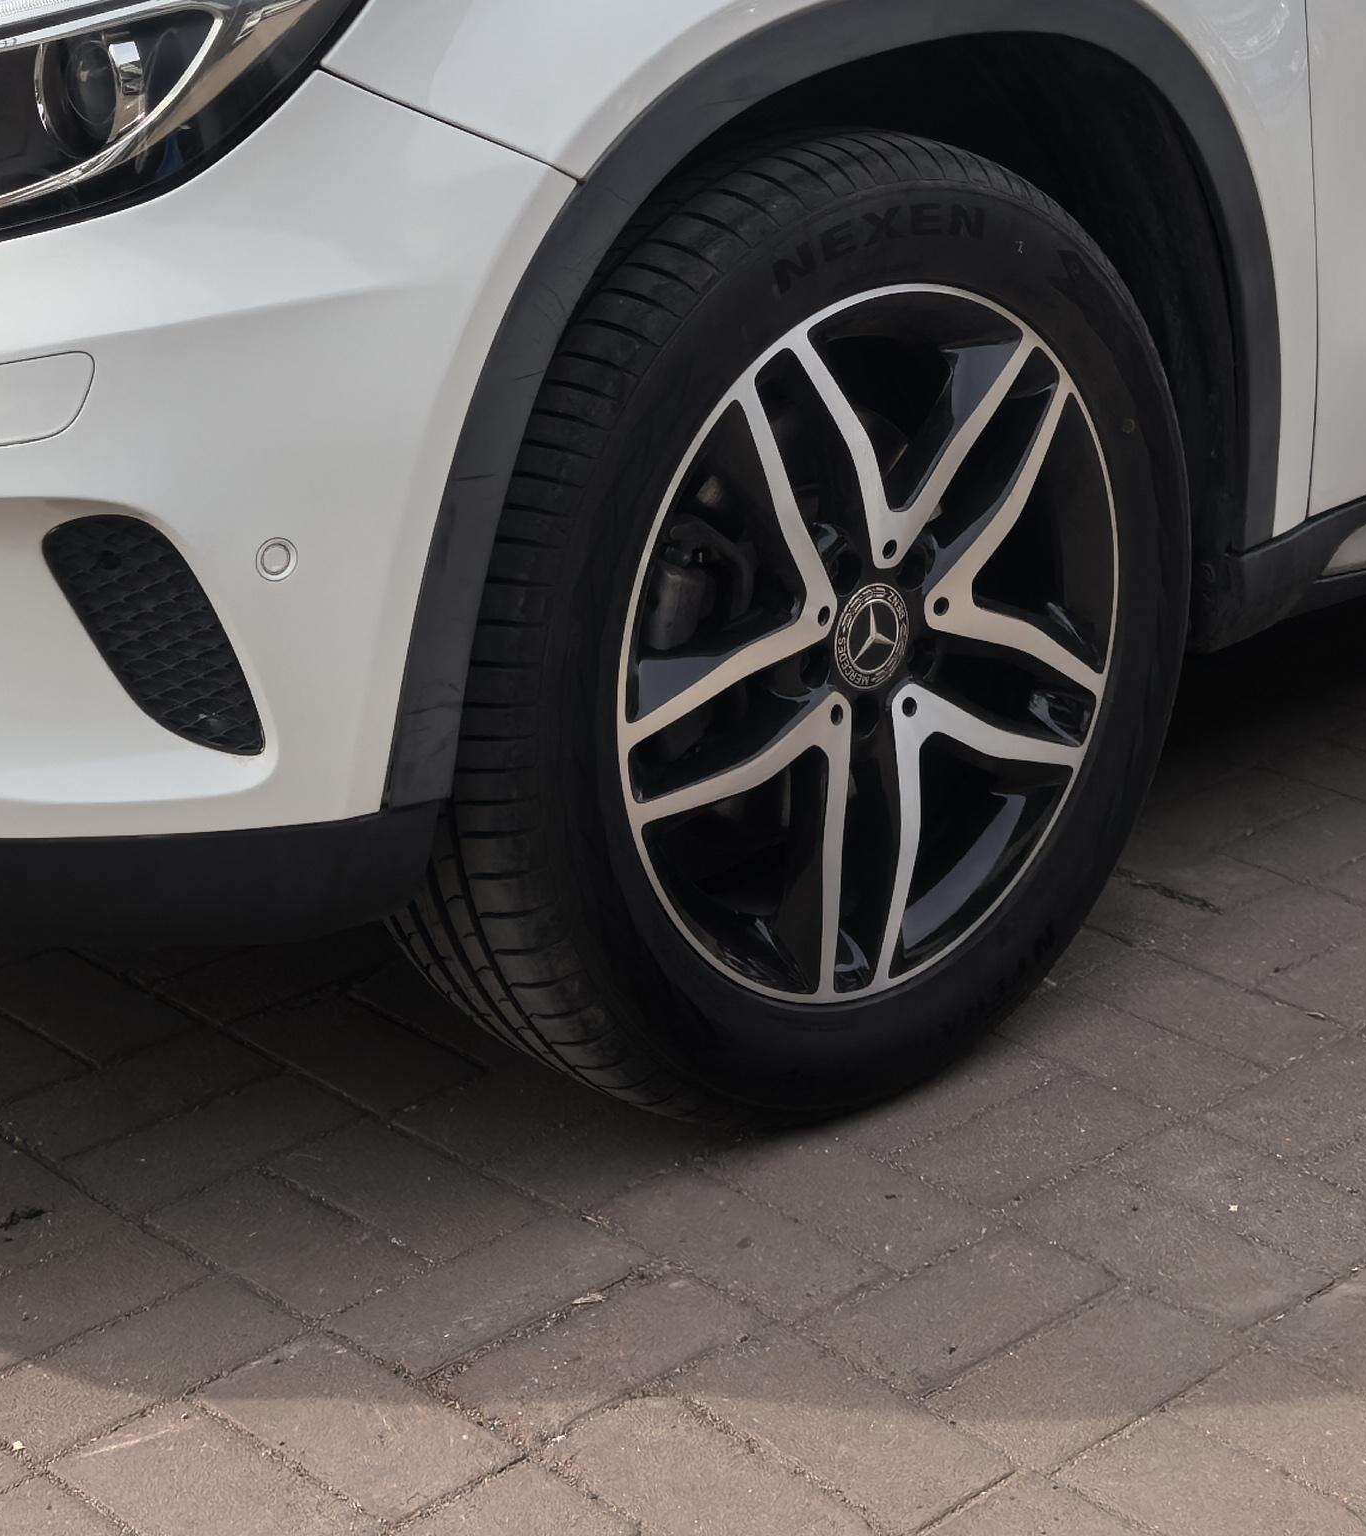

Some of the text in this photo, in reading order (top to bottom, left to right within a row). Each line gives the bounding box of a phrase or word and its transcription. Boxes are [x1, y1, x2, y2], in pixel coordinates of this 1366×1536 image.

[769, 202, 986, 295] NEXEN
[887, 591, 906, 620] BENZ
[837, 636, 871, 686] MERCEDES
